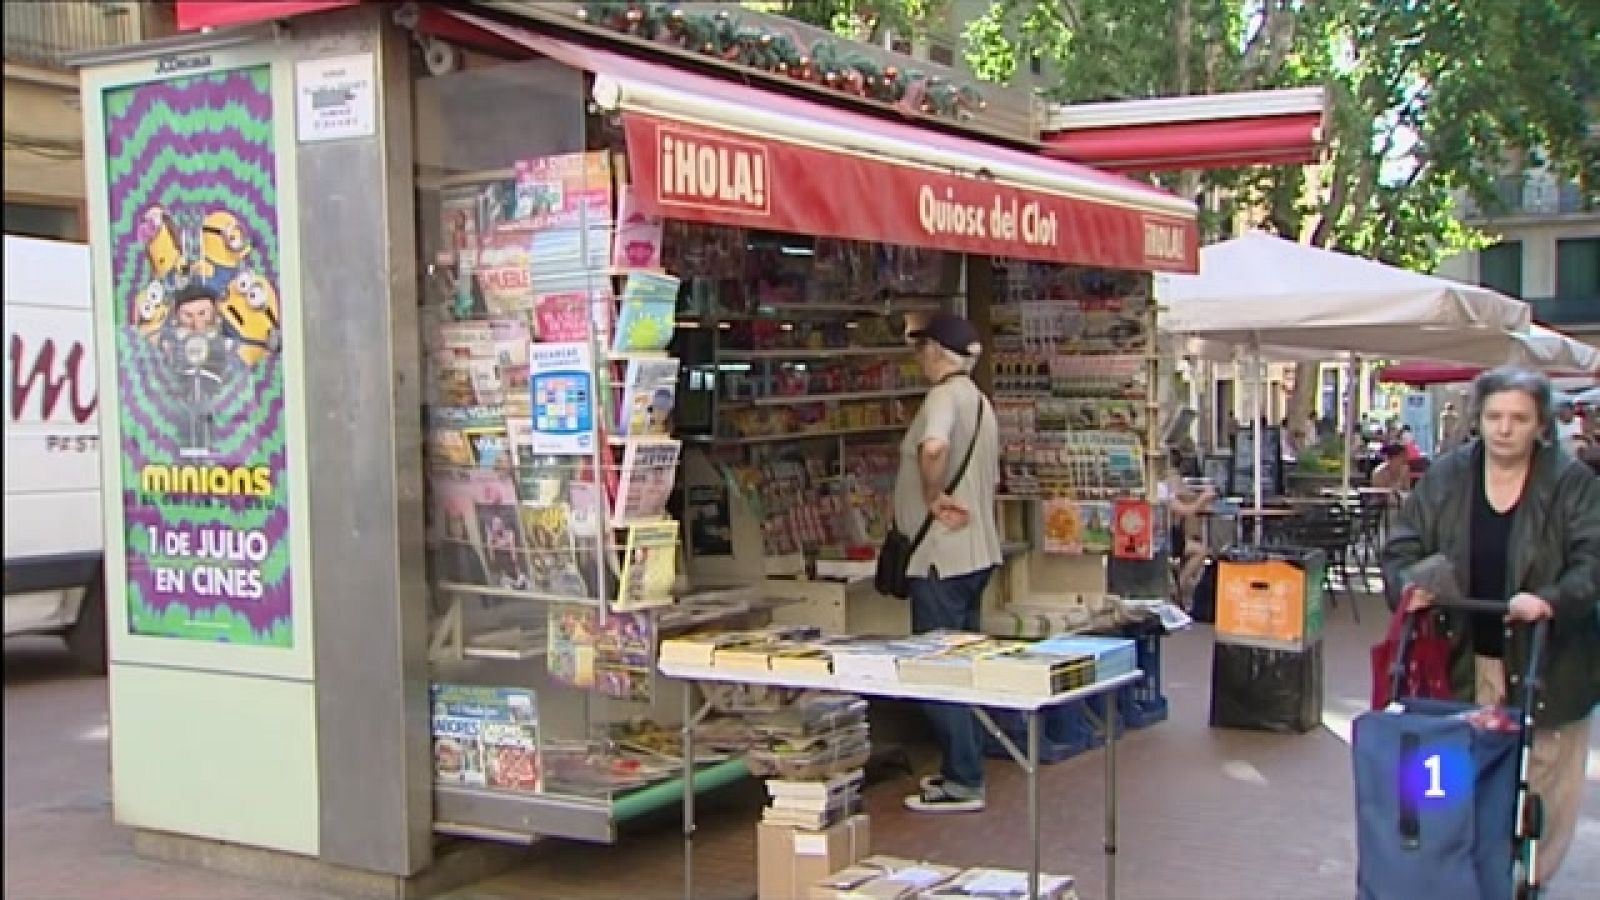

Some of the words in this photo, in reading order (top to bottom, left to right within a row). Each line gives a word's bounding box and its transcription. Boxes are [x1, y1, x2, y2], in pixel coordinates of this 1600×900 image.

[663, 134, 764, 207] ¡HOLA!
[919, 184, 986, 236] Quiosc
[989, 195, 1018, 240] del
[1021, 201, 1057, 245] Clot
[148, 524, 158, 556] 1
[164, 531, 191, 556] DE
[196, 529, 268, 561] JULIO
[156, 566, 186, 593] EN
[191, 565, 263, 598] CINES
